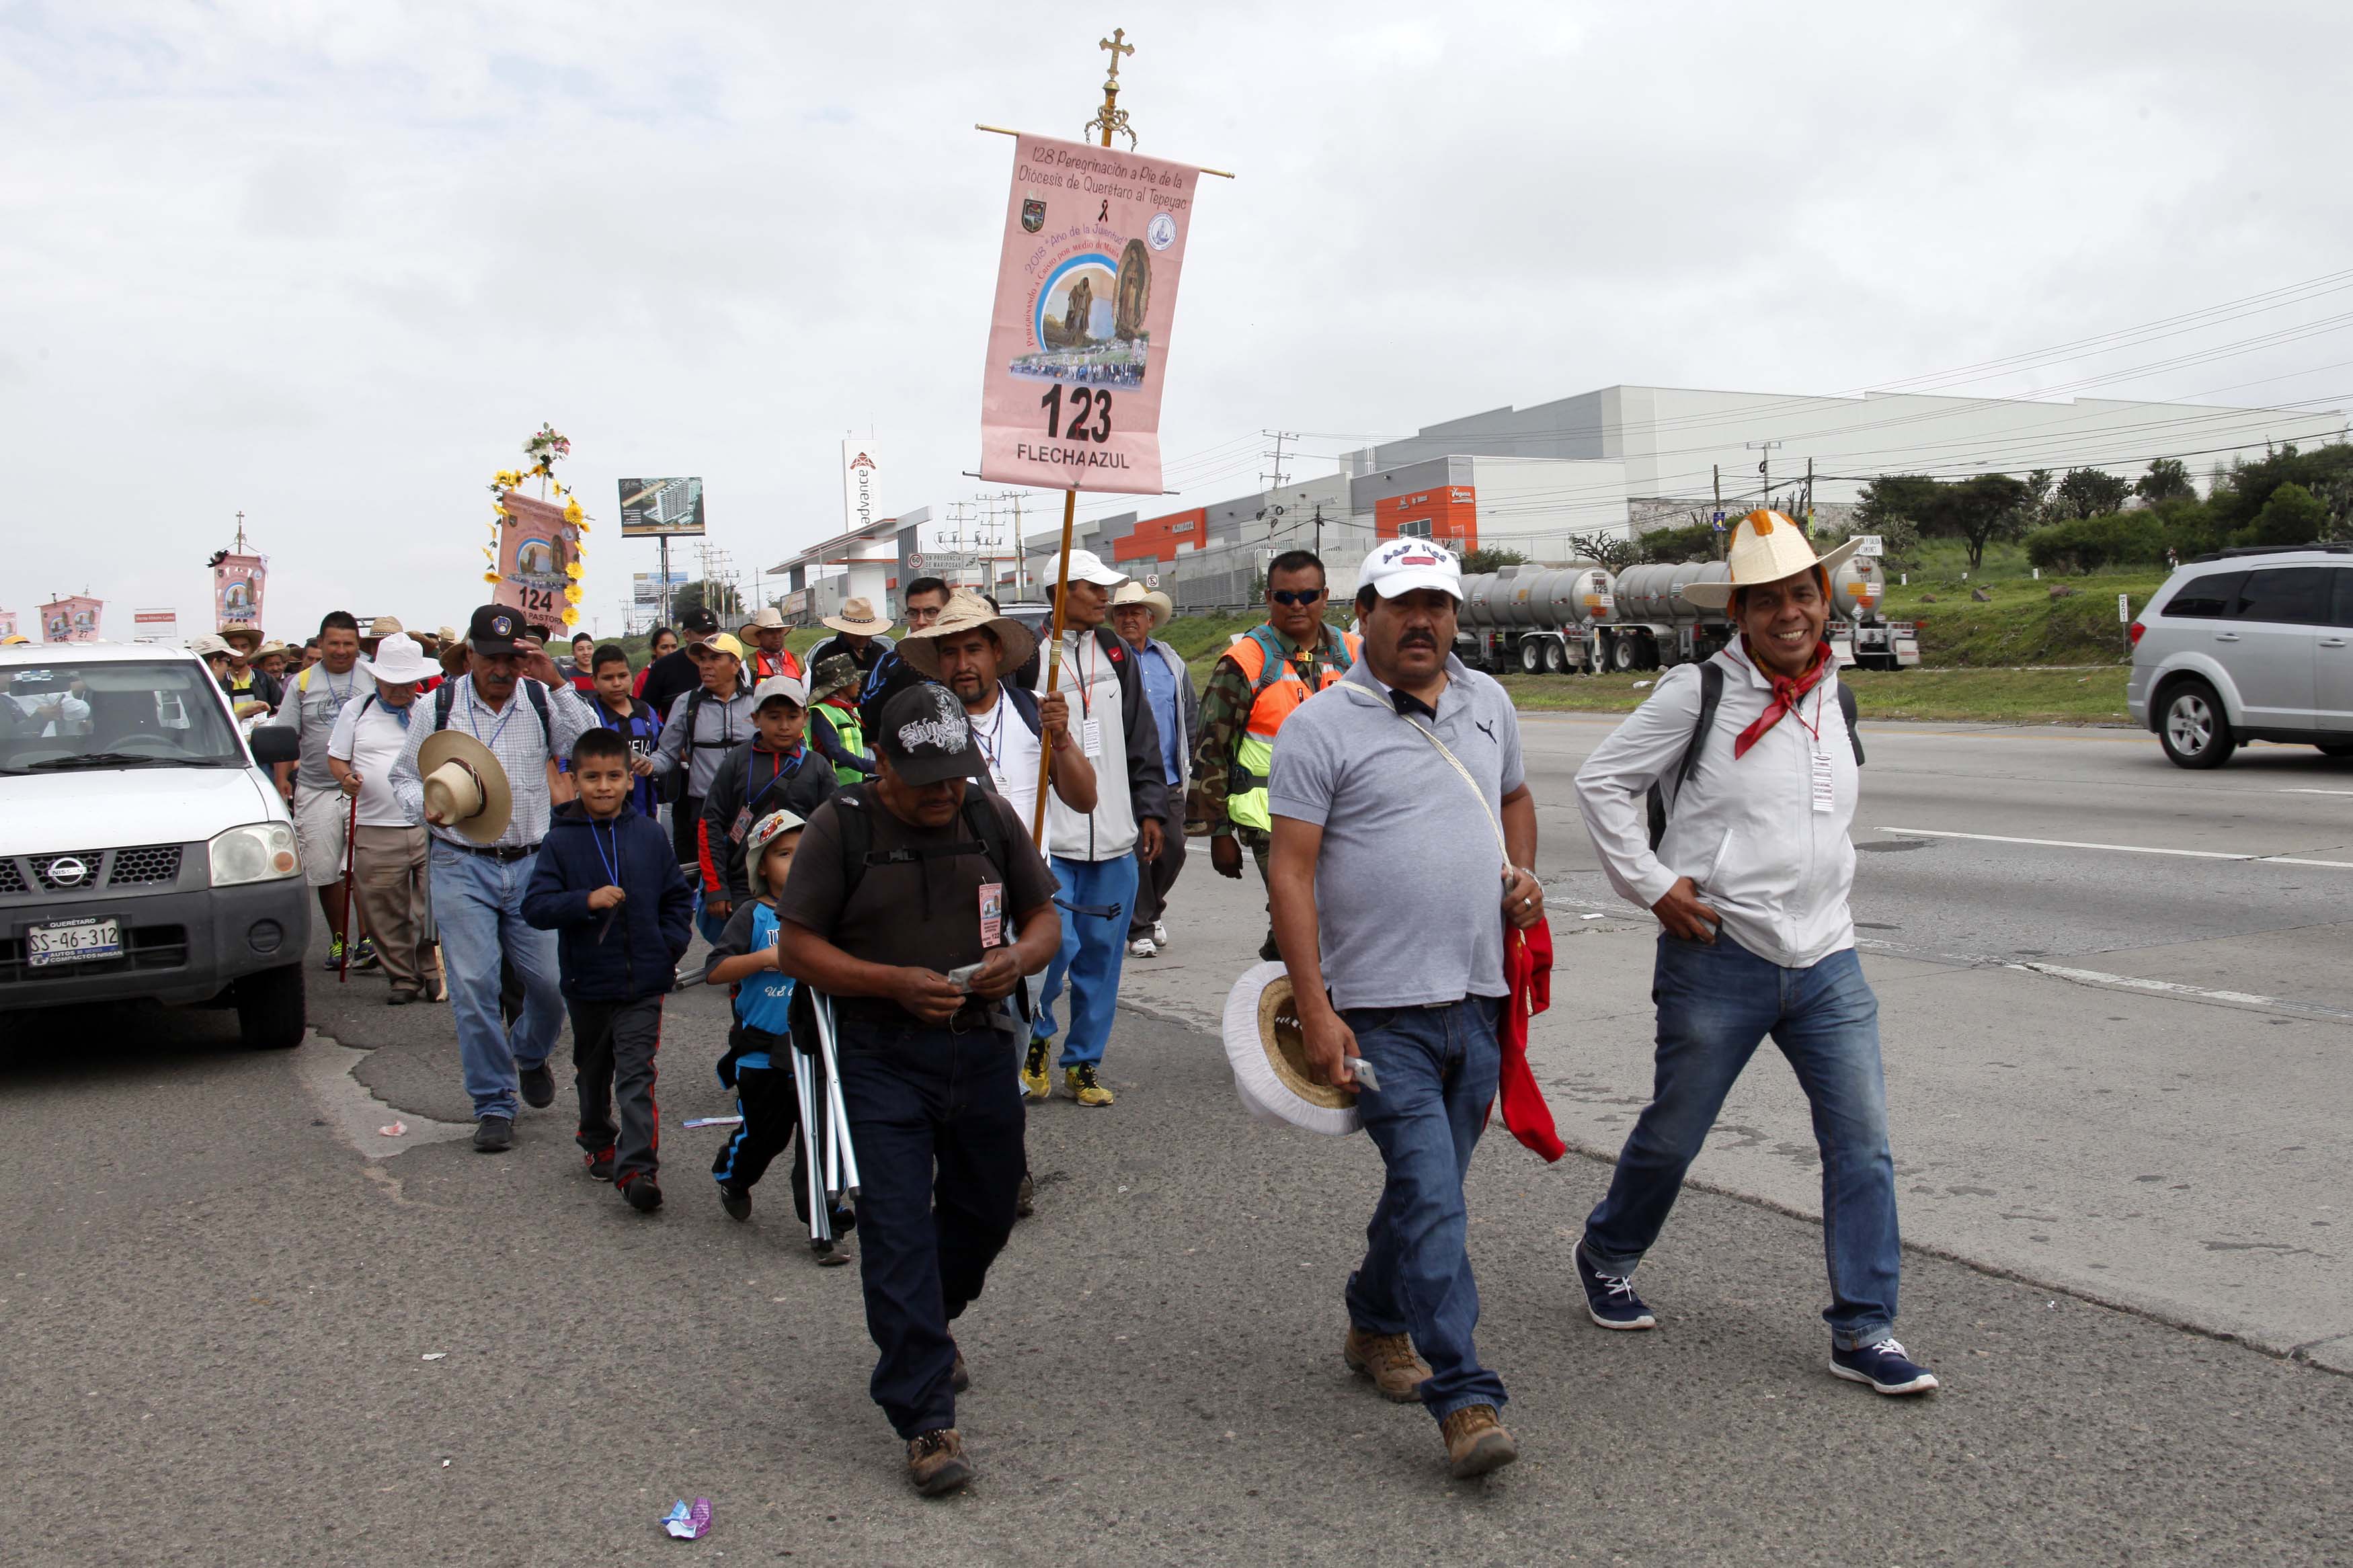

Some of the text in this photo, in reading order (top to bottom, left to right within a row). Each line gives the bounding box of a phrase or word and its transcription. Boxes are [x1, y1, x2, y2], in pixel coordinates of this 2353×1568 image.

[1033, 147, 1183, 188] 128 Peregrinación a Pie de la
[1019, 165, 1187, 212] Diócesis de Querétaro al Tepeyac
[1025, 247, 1047, 274] 2018
[1070, 225, 1080, 237] de
[1083, 224, 1090, 234] la
[1041, 384, 1112, 444] 123
[856, 469, 871, 524] advance
[519, 586, 553, 612] 124
[1593, 585, 1608, 593] 129
[50, 918, 96, 927] QUERÉTARO
[30, 927, 117, 952] SS-46-312
[50, 950, 123, 962] COMPACTOS NISSAN
